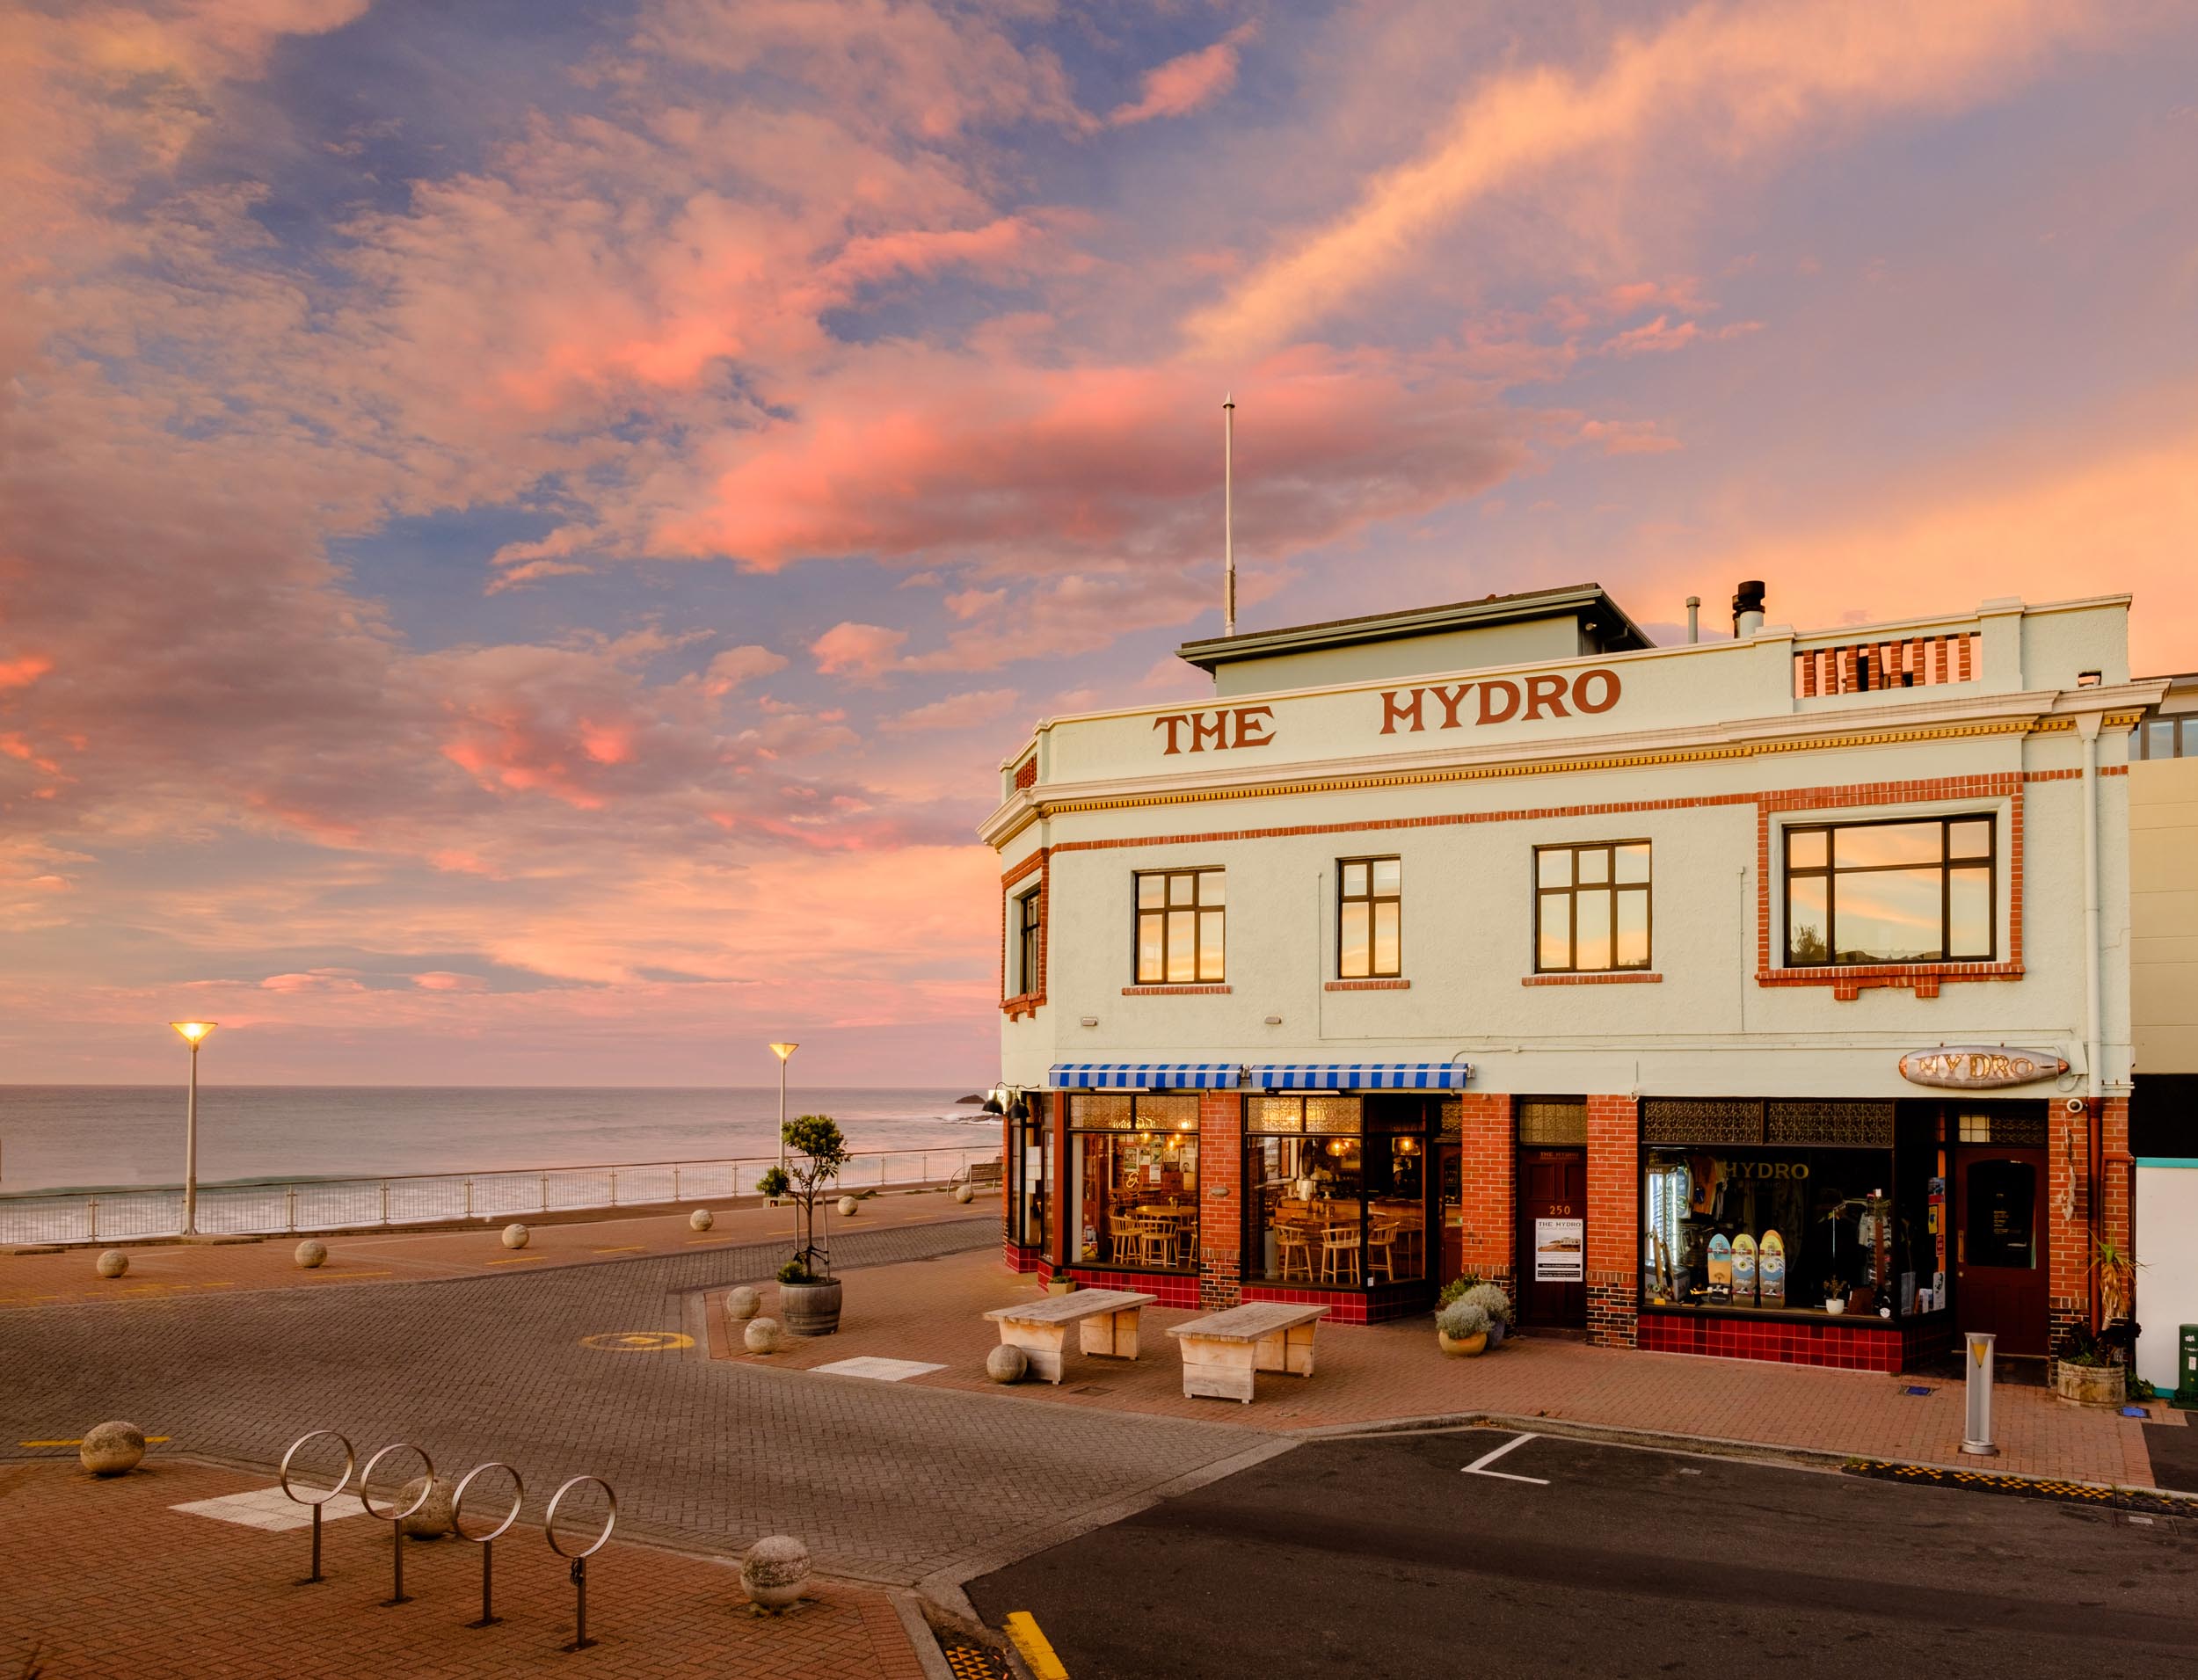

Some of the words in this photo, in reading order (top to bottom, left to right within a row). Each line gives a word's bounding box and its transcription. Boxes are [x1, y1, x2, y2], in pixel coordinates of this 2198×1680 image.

[1153, 706, 1277, 755] THE
[1379, 669, 1621, 735] HYDRO
[1915, 1053, 2034, 1080] HYDRO
[1724, 1161, 1809, 1180] HYDRO
[1549, 1205, 1570, 1215] 250
